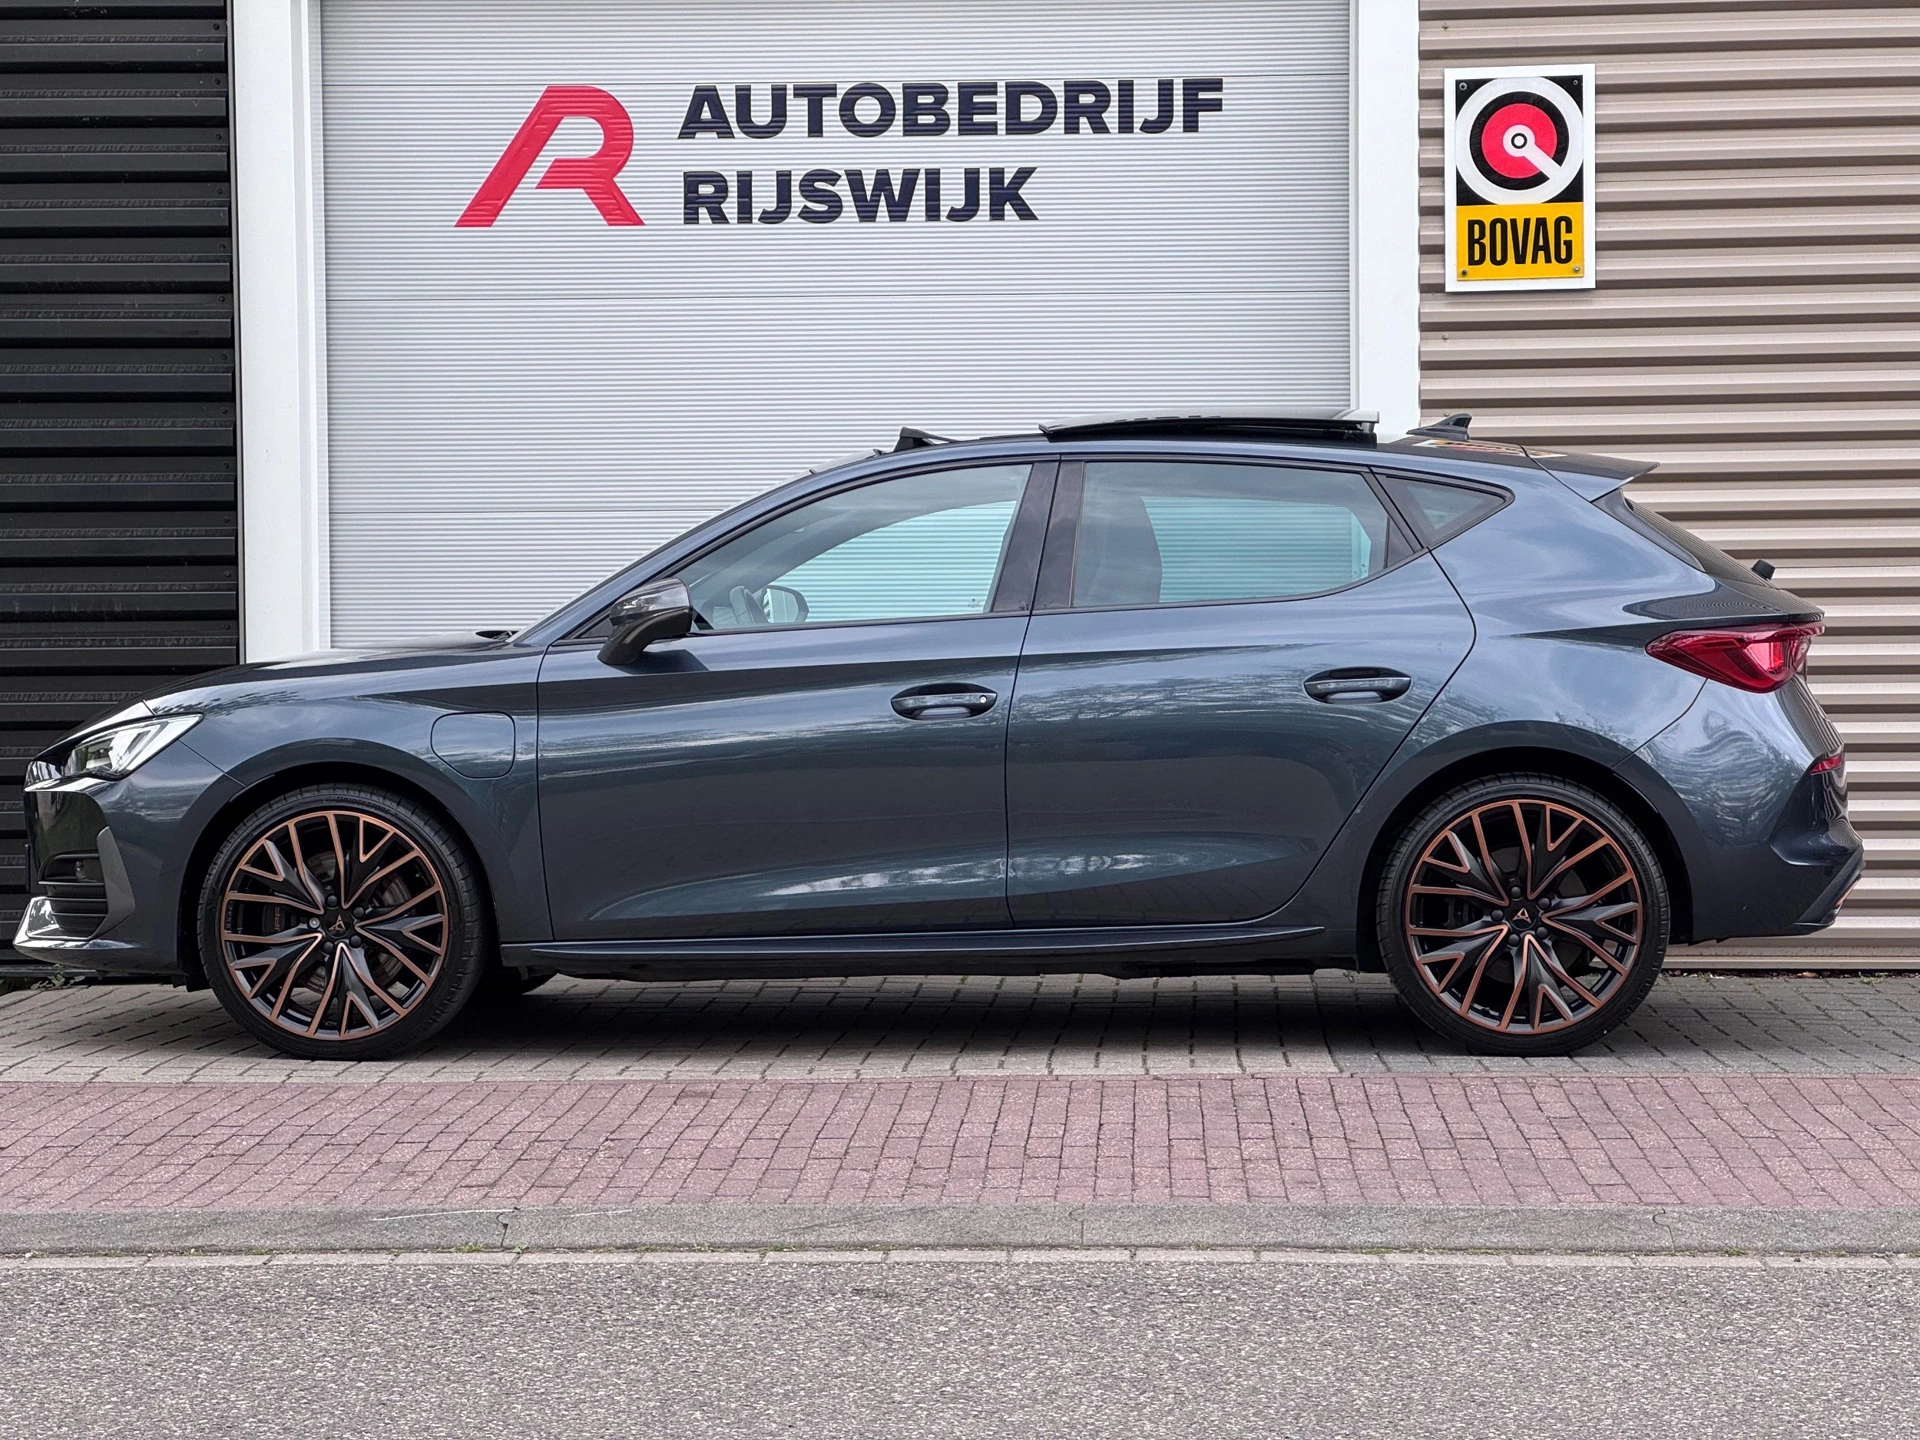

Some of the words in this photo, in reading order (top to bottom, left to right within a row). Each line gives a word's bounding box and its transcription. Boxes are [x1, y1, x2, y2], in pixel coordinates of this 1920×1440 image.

[678, 78, 1223, 140] AUTOBEDRIJF
[682, 166, 1039, 225] RIJSWIJK
[1468, 216, 1573, 266] BOVAG
